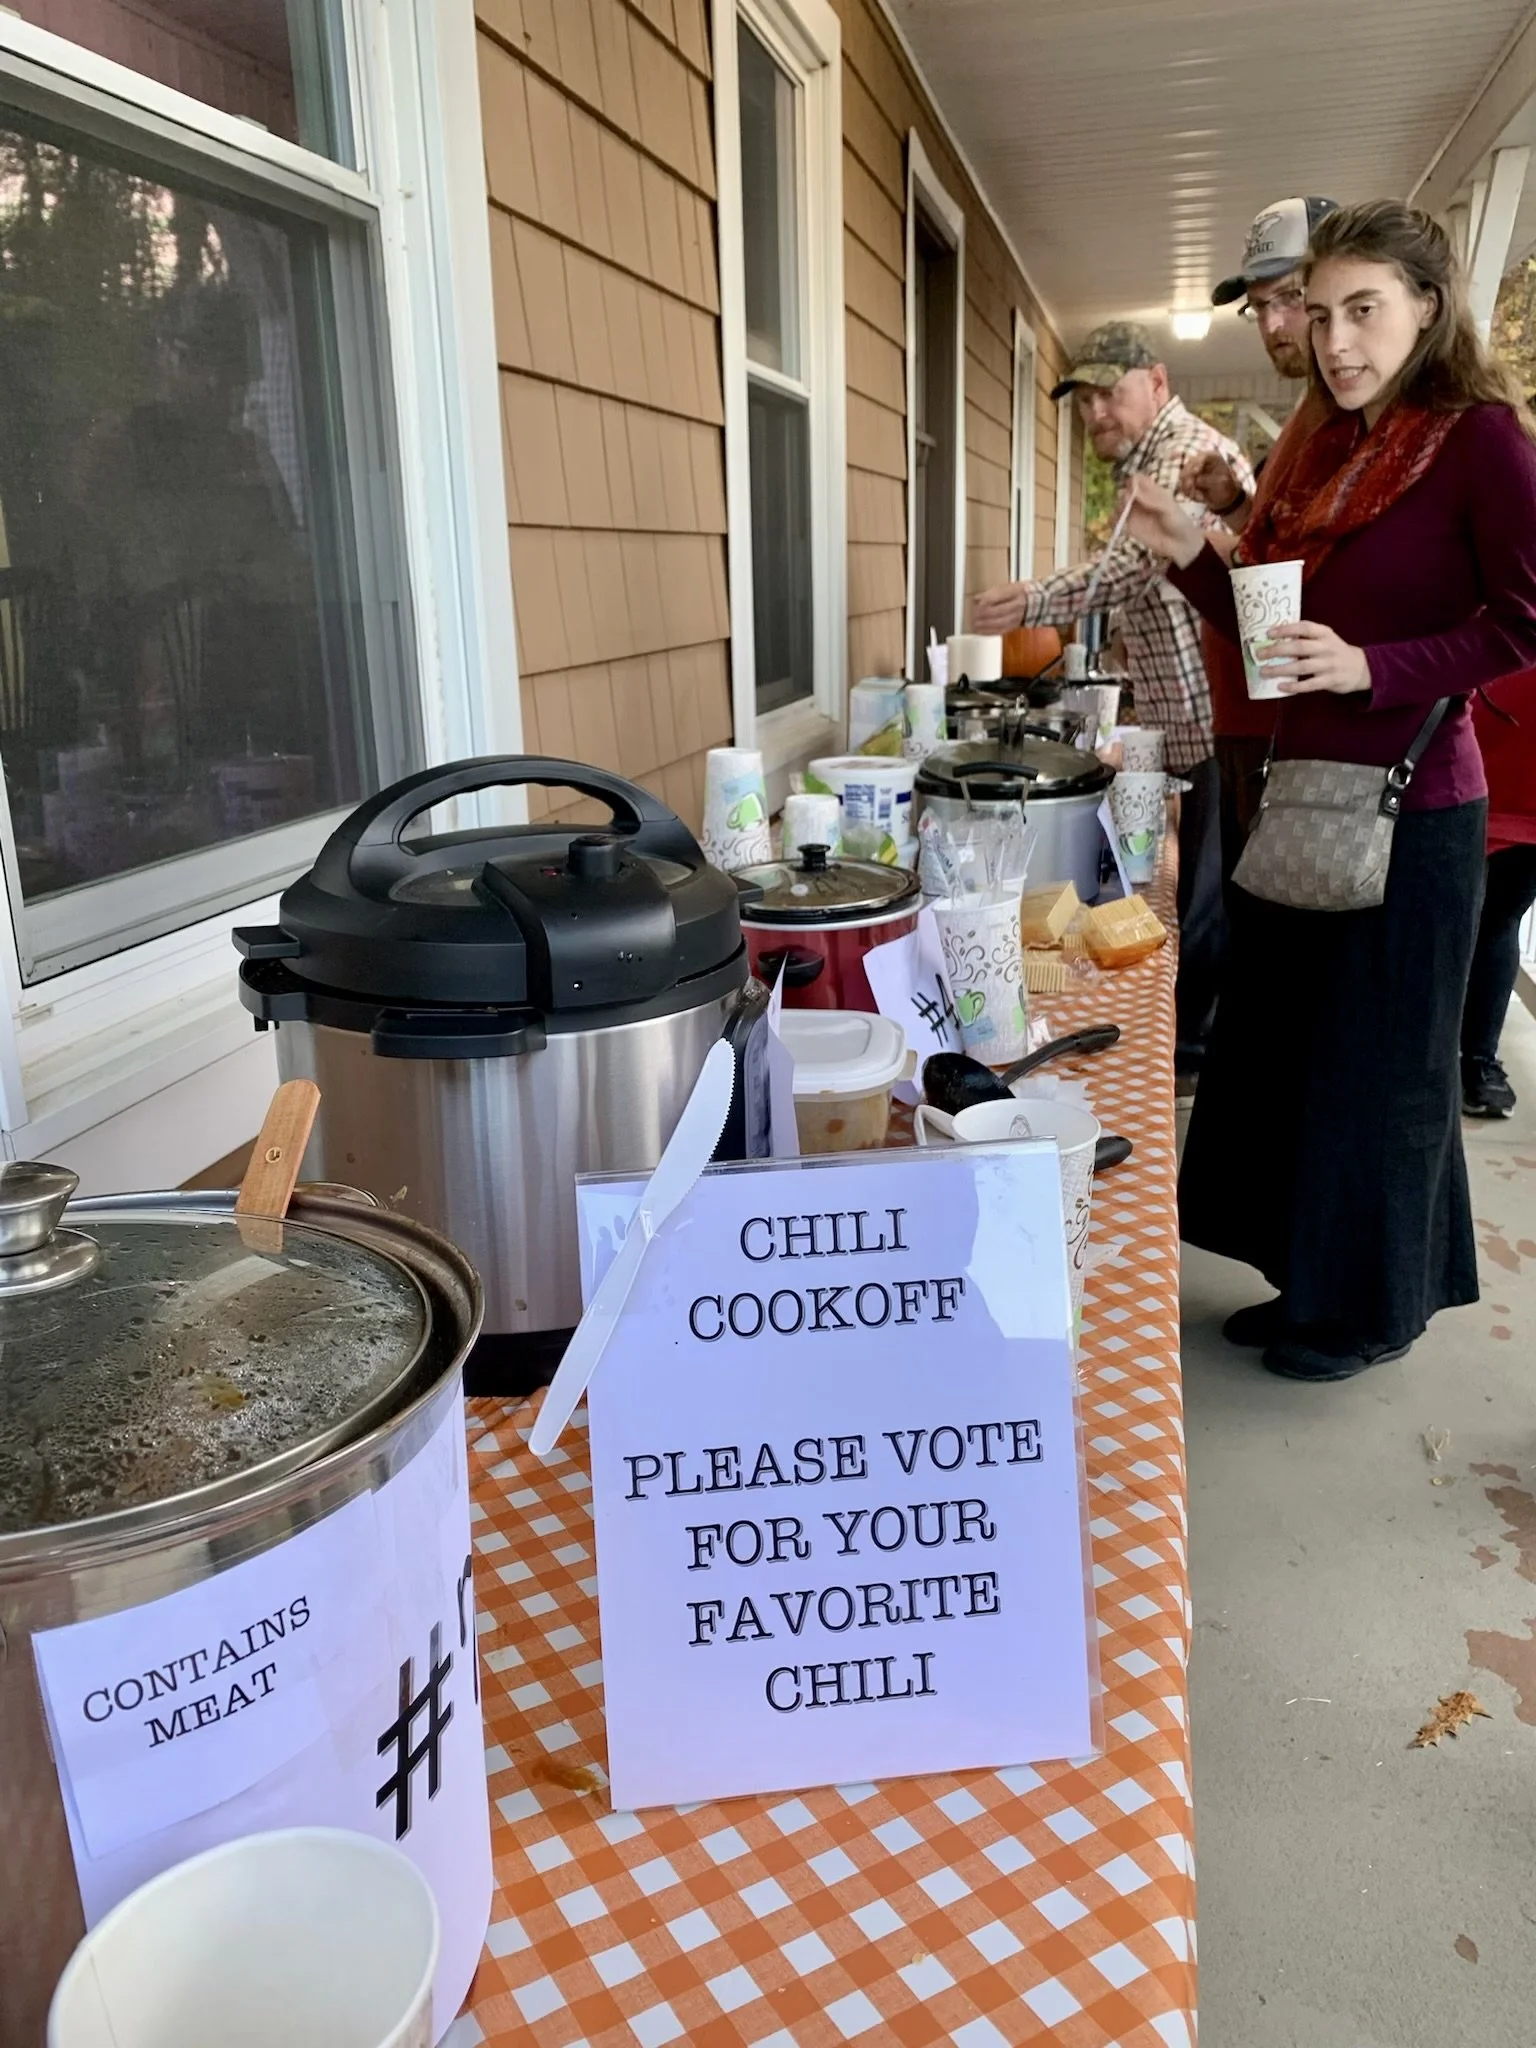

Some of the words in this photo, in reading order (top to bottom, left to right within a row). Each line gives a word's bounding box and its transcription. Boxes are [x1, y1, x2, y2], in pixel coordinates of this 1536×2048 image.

[739, 1207, 909, 1262] CHILI
[688, 1277, 965, 1342] COOKOFF
[622, 1434, 867, 1501] PLEASE
[881, 1419, 1044, 1477] VOTE
[684, 1516, 811, 1571] FOR
[821, 1498, 996, 1556] YOUR
[686, 1571, 1001, 1647] FAVORITE
[83, 1596, 311, 1723] CONTAINS
[765, 1651, 937, 1713] CHILI
[143, 1662, 279, 1748] MEAT
